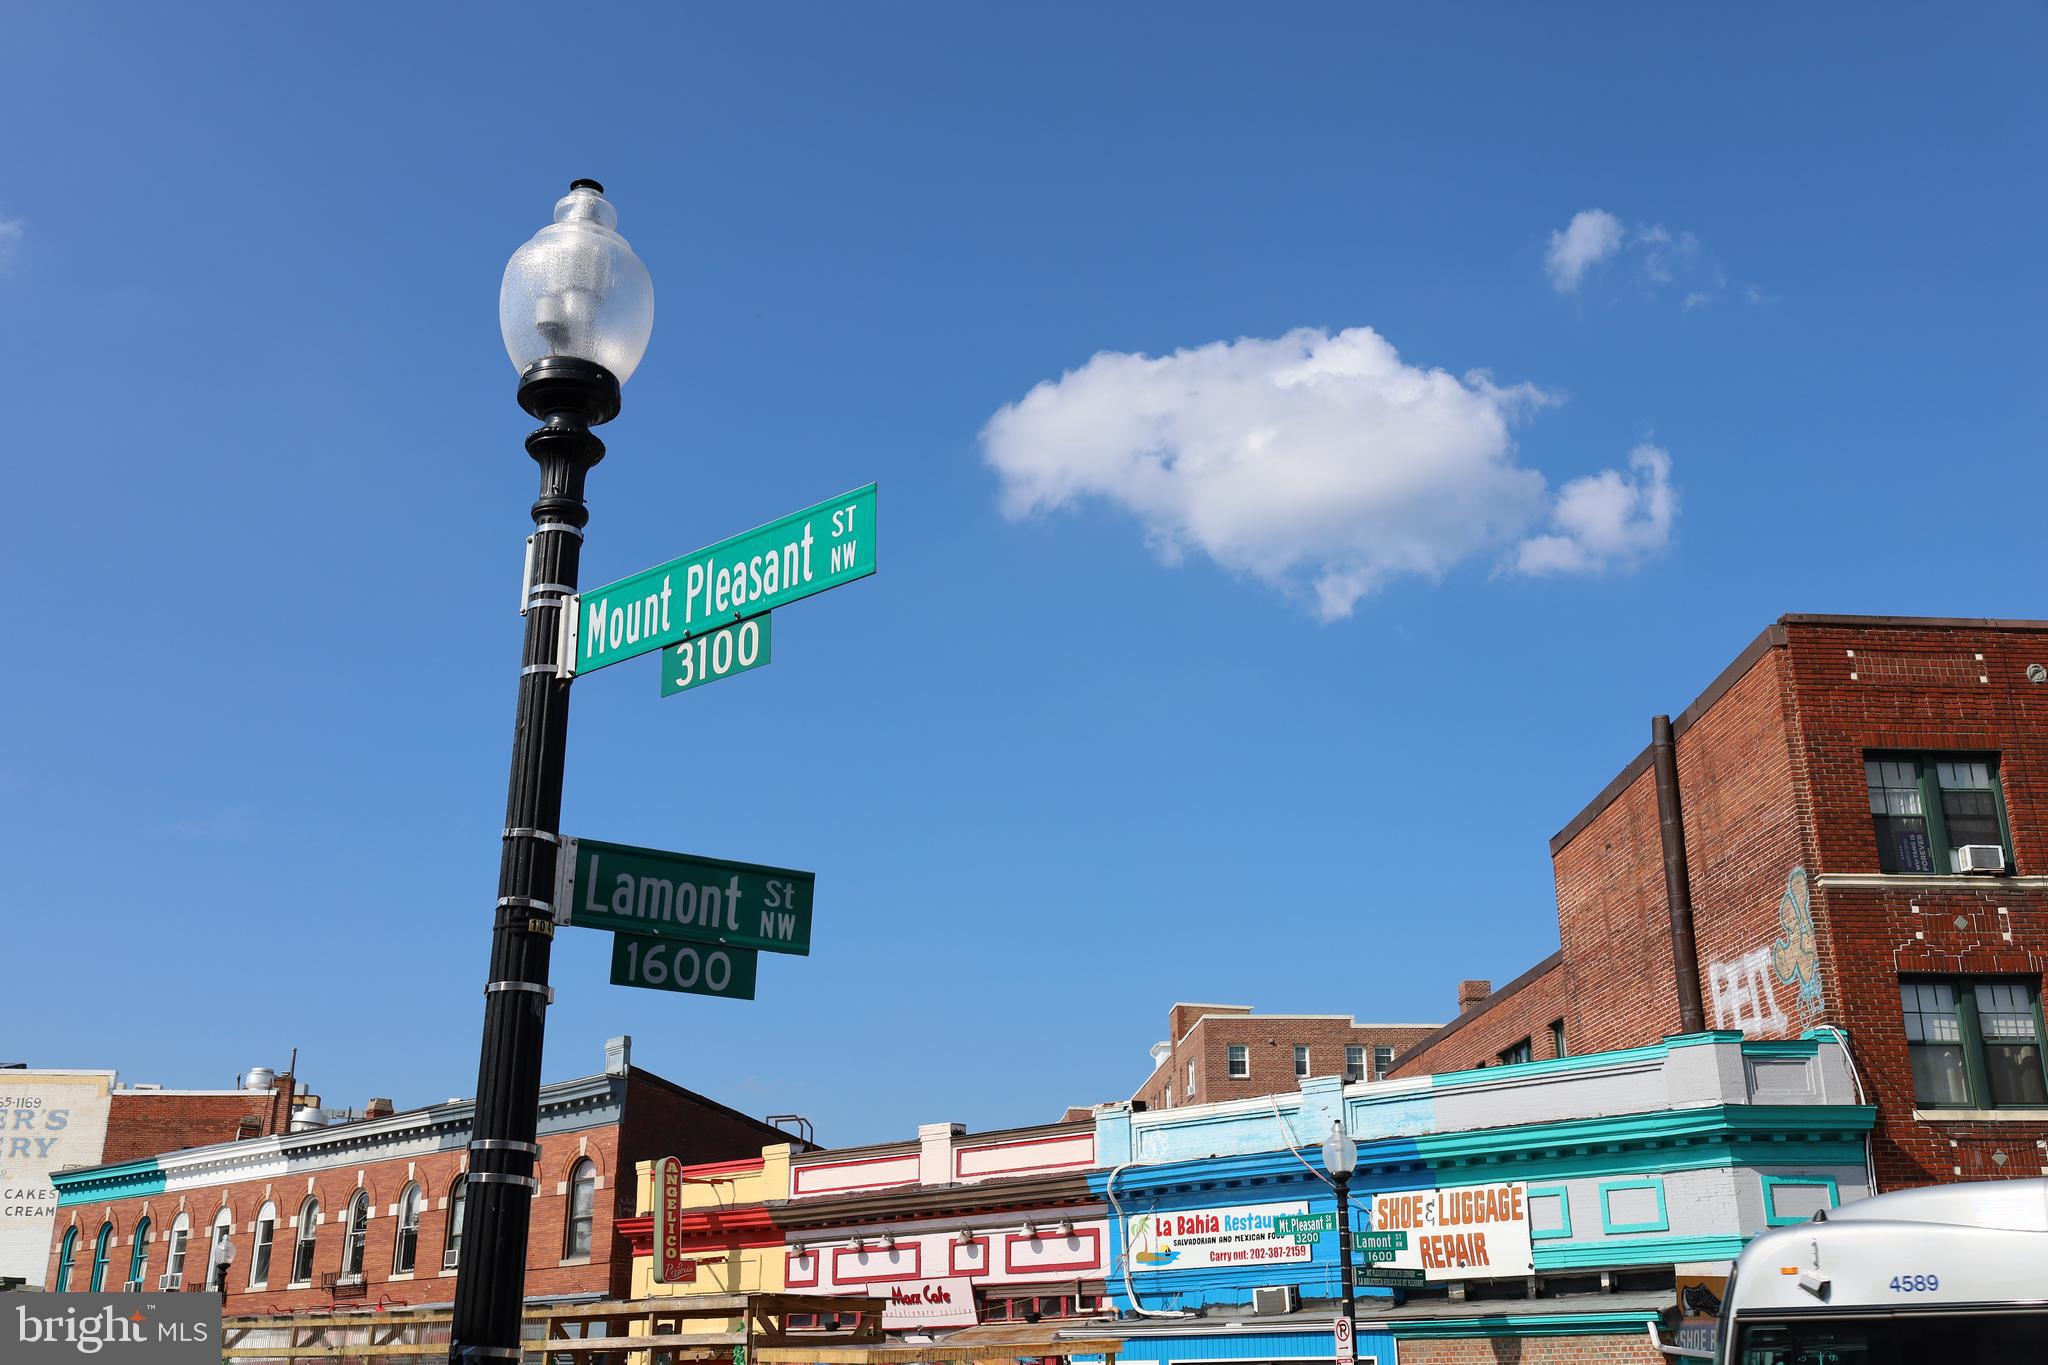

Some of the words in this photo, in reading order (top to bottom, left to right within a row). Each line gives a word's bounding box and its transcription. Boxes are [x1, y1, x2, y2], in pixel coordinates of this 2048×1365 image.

[831, 540, 857, 574] NW
[586, 574, 672, 658] Mount
[685, 521, 814, 623] Pleasant
[831, 505, 857, 538] ST
[676, 621, 759, 687] 3100
[1917, 834, 1929, 871] FOREVER
[585, 854, 742, 931] Lamont
[764, 880, 795, 909] St
[759, 910, 796, 941] NW
[627, 941, 731, 991] 1600
[0, 1137, 58, 1158] RY
[4, 1188, 56, 1200] CAKES
[5, 1206, 55, 1217] CREAM
[665, 1162, 679, 1259] ANGELICO
[1377, 1195, 1424, 1230] SHOE
[1425, 1198, 1435, 1226] &
[1438, 1187, 1523, 1226] LUGGAGE
[1156, 1218, 1172, 1237] La
[1177, 1214, 1220, 1236] Bahia
[1291, 1216, 1324, 1231] Pleasant
[1173, 1236, 1217, 1246] SALVADORIAN
[1219, 1235, 1232, 1243] AND
[1235, 1233, 1265, 1242] MEXICAN
[1296, 1233, 1319, 1243] 3200
[1356, 1234, 1392, 1248] Lamont
[1210, 1251, 1232, 1262] Carry
[1233, 1249, 1249, 1259] out:
[1250, 1245, 1306, 1259] 202-387-2159
[1368, 1251, 1393, 1261] 1600
[1419, 1232, 1490, 1269] REPAIR
[1889, 1274, 1939, 1292] 4589
[892, 1286, 922, 1306] Marx
[923, 1285, 951, 1304] Cafe
[1680, 1329, 1706, 1351] SHOE
